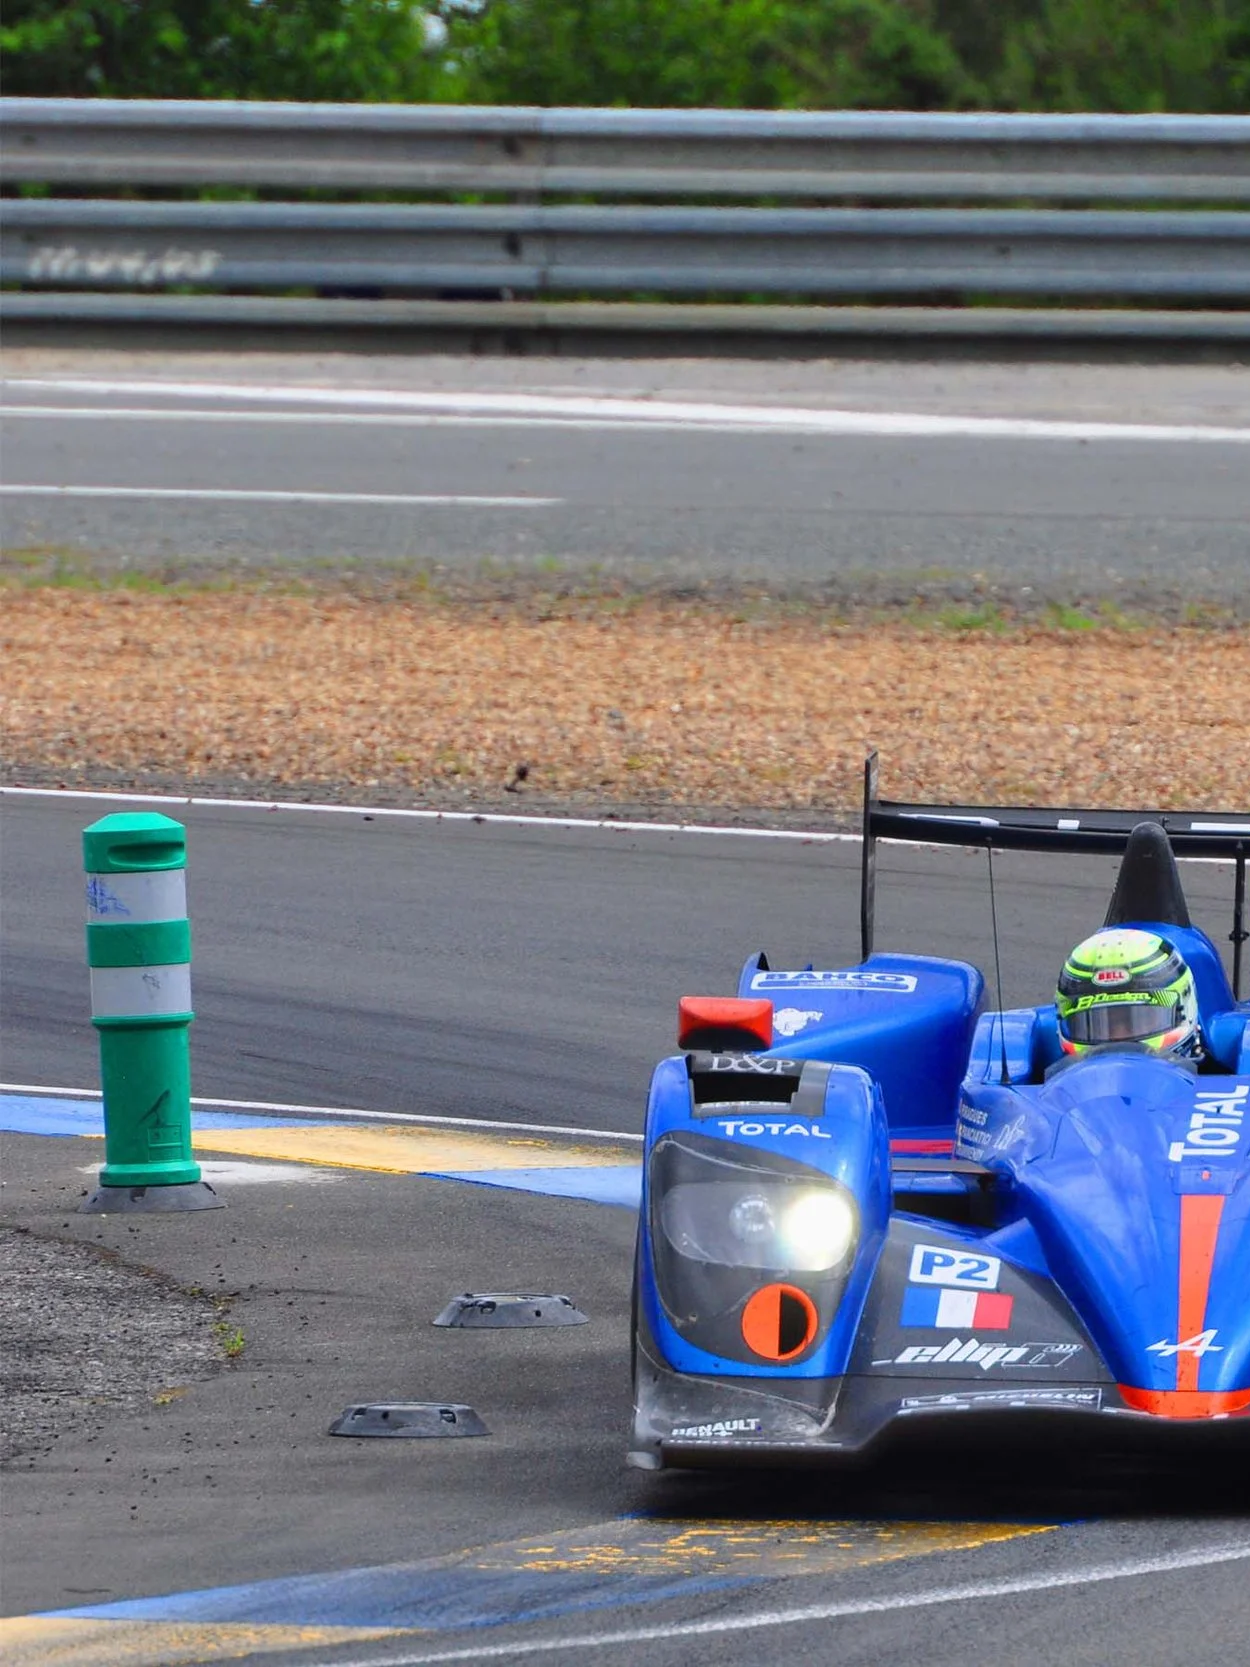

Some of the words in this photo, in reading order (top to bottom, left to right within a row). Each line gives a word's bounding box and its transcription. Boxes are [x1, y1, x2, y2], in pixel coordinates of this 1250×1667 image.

[1098, 971, 1124, 980] BELL
[710, 1054, 795, 1074] D&P
[718, 1121, 832, 1139] TOTAL
[1168, 1085, 1250, 1162] TOTAL
[919, 1251, 991, 1282] P2
